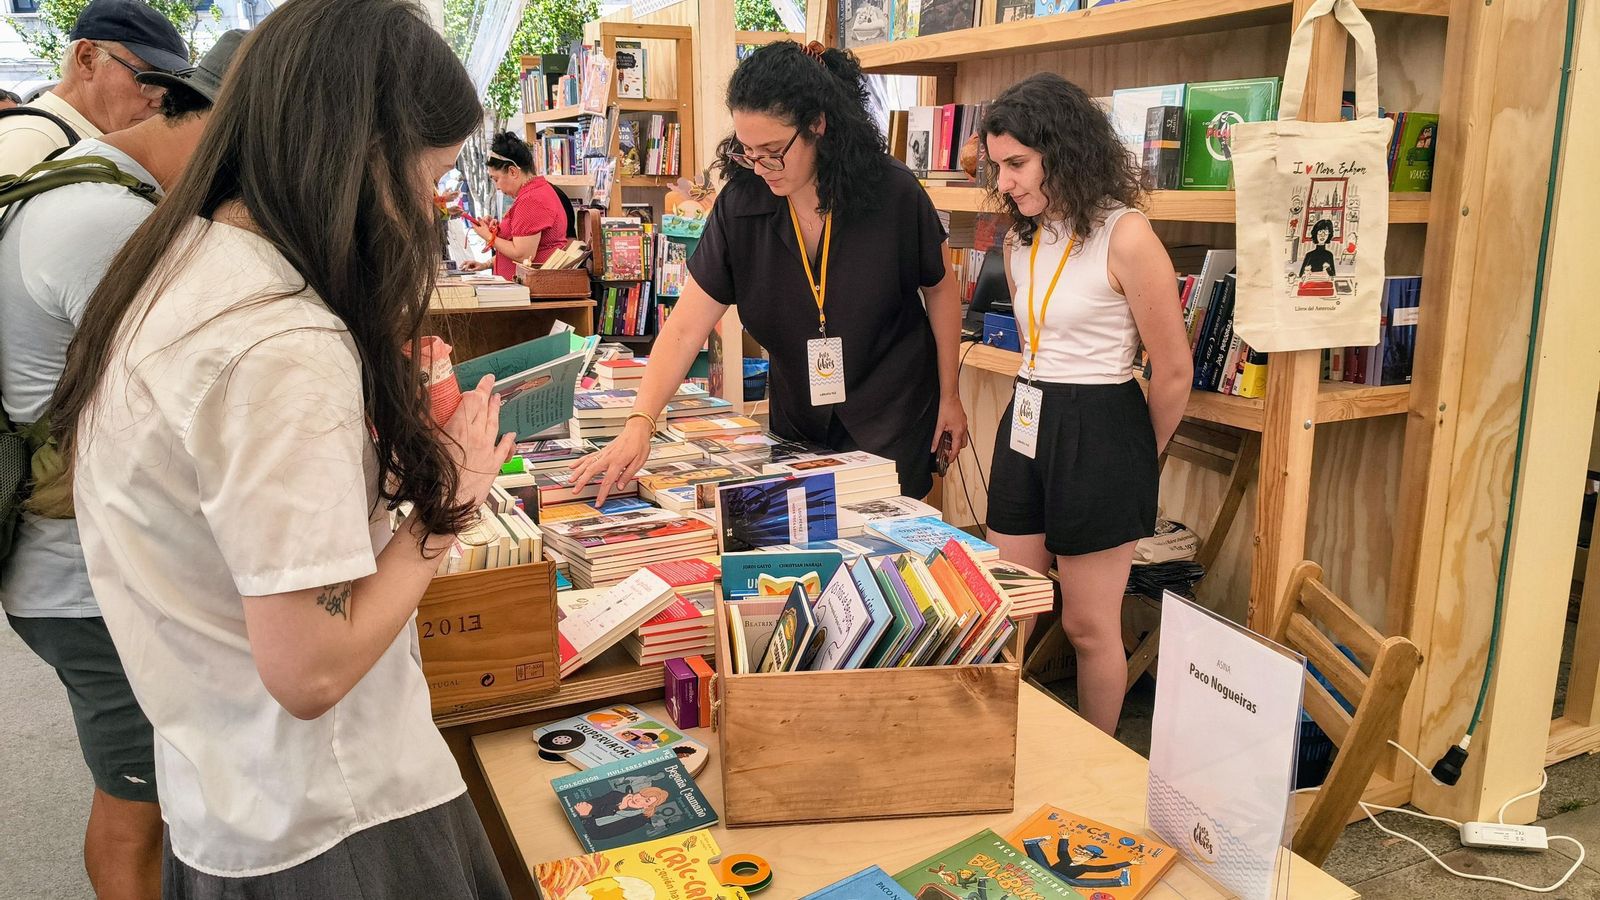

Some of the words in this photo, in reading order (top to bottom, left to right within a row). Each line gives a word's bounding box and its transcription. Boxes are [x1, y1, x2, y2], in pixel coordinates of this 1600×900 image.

[1315, 161, 1335, 175] Nora
[1338, 160, 1367, 178] Ephron
[1189, 662, 1209, 684] Paco
[1211, 675, 1257, 714] Nogueiras
[664, 764, 687, 790] Begoña
[680, 787, 706, 818] Caamaño
[876, 881, 892, 897] PACO
[993, 841, 1016, 858] PACO
[1019, 860, 1070, 898] NOGUEIRAS
